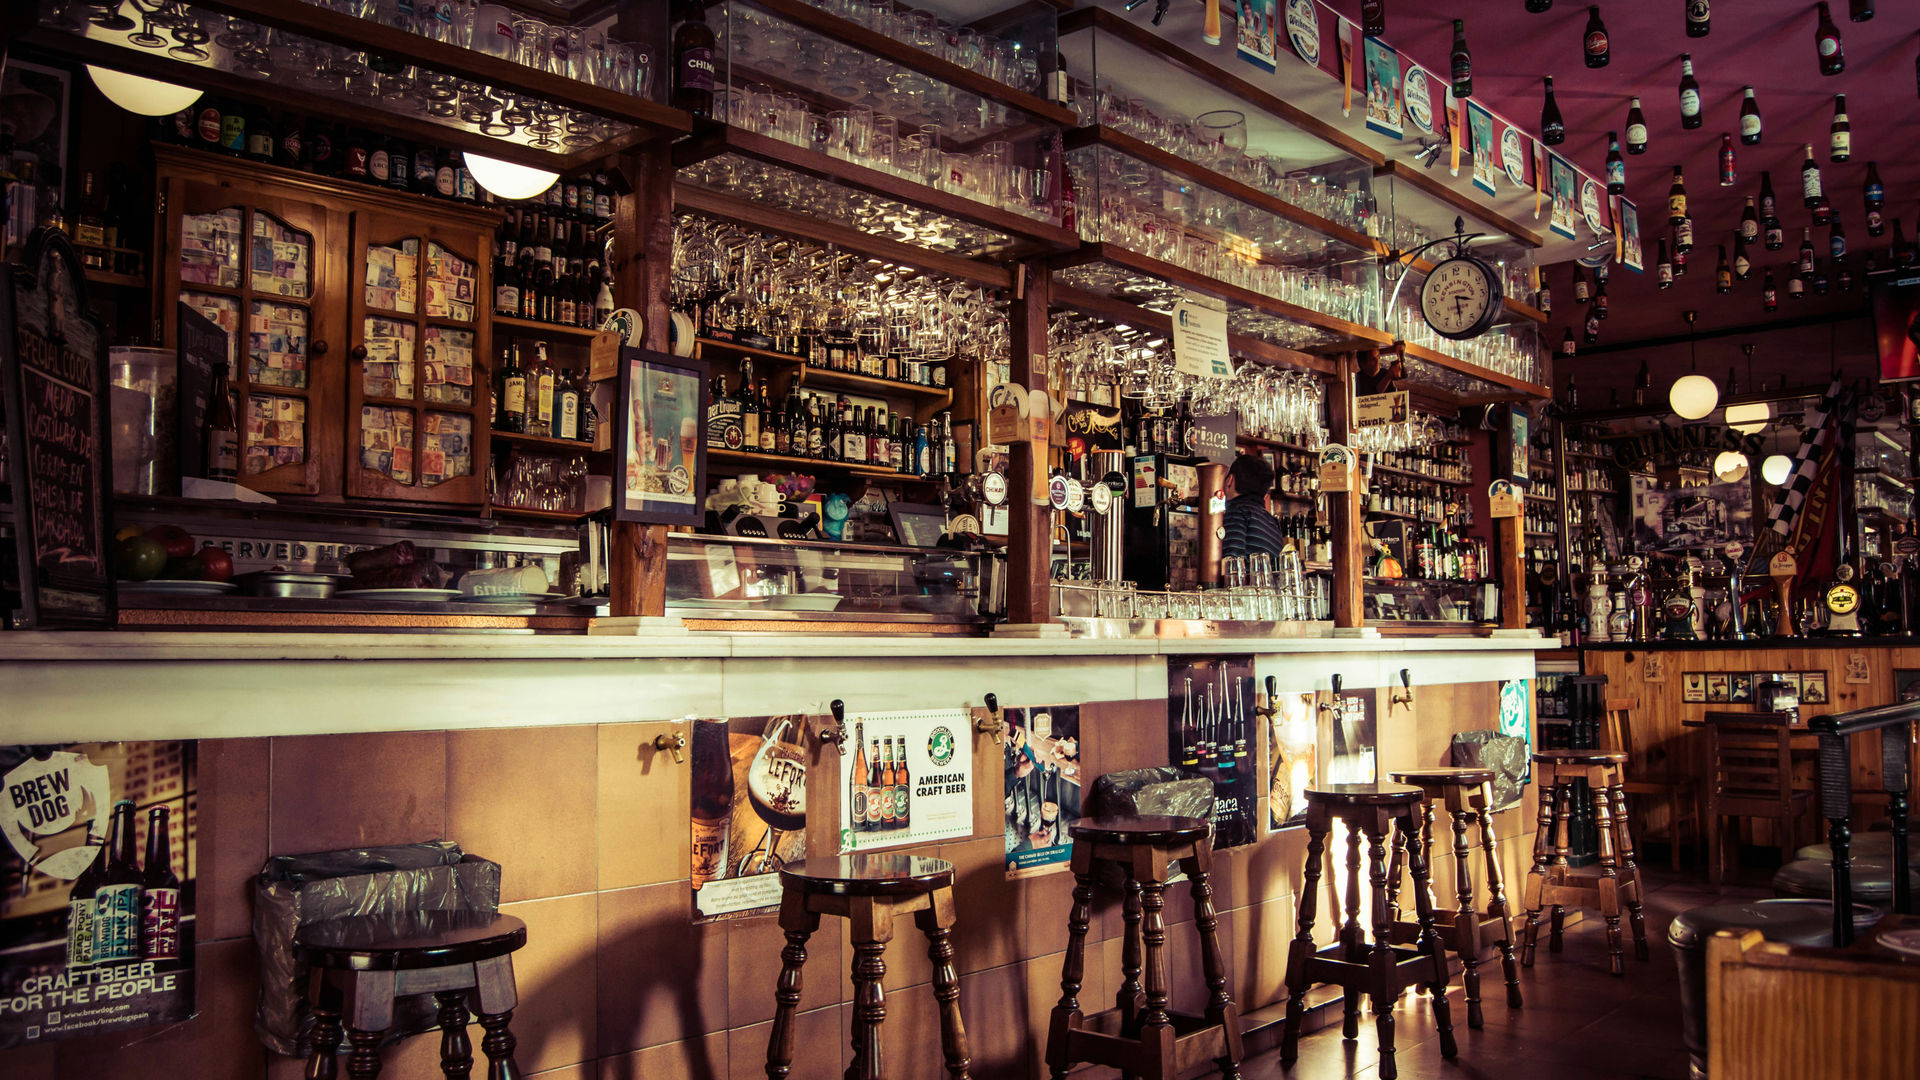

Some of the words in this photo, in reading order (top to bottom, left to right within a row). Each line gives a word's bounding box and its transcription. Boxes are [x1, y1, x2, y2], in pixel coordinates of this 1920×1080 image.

[1440, 279, 1475, 301] KENSINGTON
[1613, 427, 1766, 470] GUINNESS
[9, 768, 69, 809] BREW
[916, 786, 942, 797] CRAFT
[945, 784, 966, 794] BEER
[918, 773, 964, 786] AMERICAN
[28, 795, 70, 828] DOG
[117, 889, 129, 911] IPA
[78, 903, 86, 931] PONY
[84, 935, 92, 961] PALE
[101, 916, 111, 959] BREWDOG
[116, 915, 128, 956] PUNK
[22, 971, 96, 994] CRAFT
[100, 962, 155, 983] BEER
[0, 995, 43, 1016] FOR
[46, 988, 90, 1007] THE
[95, 975, 176, 1000] PEOPLE
[64, 1003, 130, 1019] www.brewdog.com
